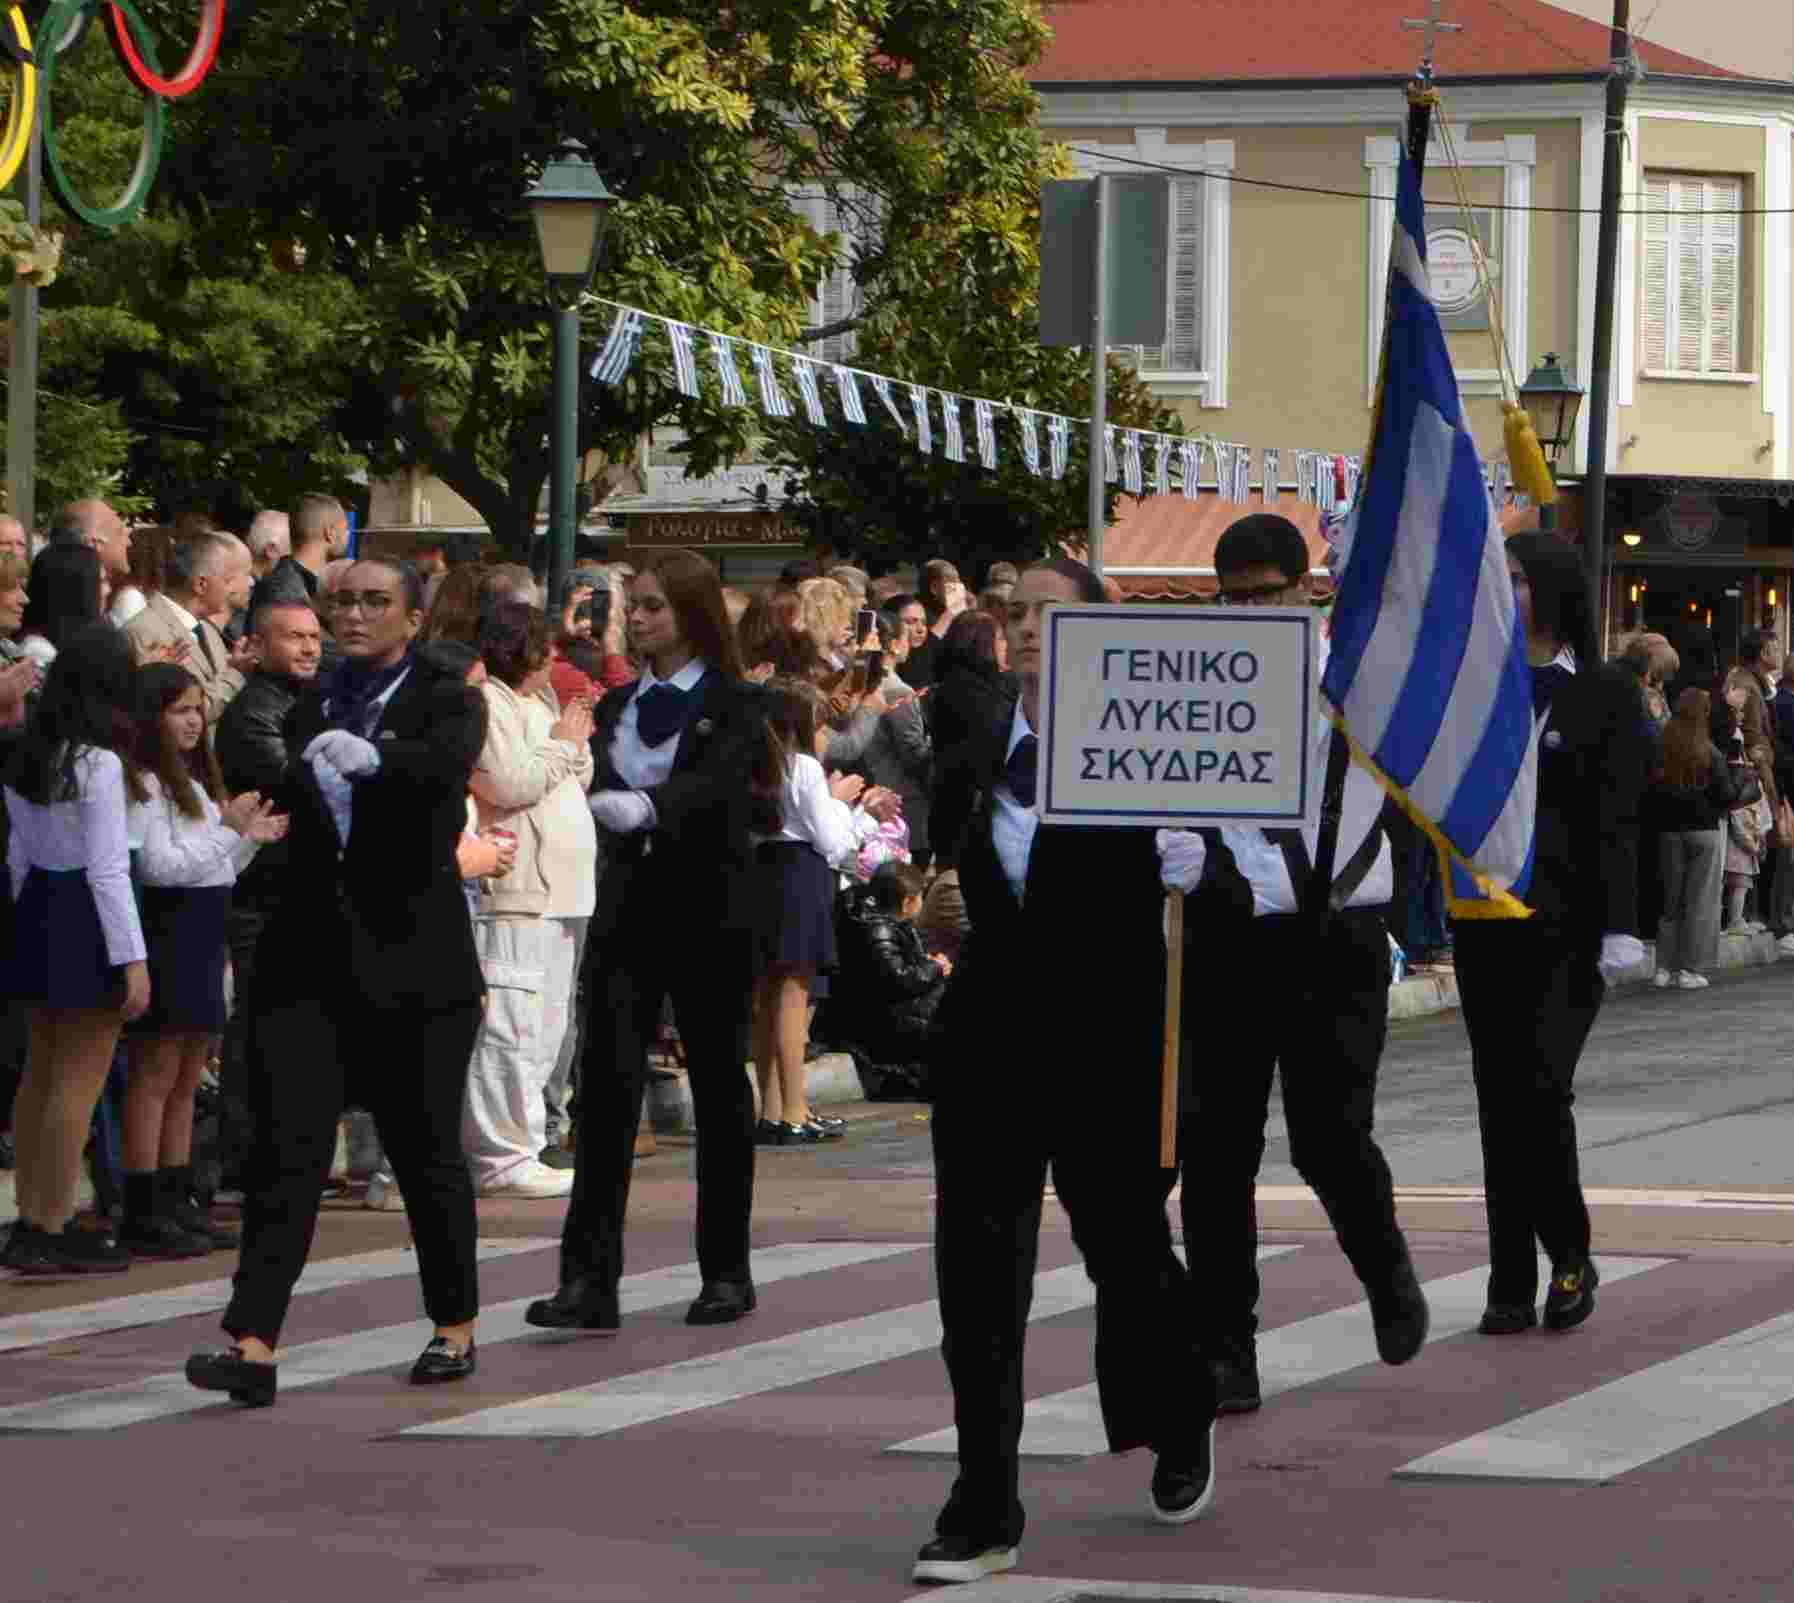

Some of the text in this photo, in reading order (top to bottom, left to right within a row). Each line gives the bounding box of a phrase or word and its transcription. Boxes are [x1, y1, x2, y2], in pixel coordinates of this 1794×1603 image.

[1102, 648, 1259, 684] ΓΕΝΙΚΟ
[1099, 698, 1257, 733] ΛΥΚΕΙΟ
[1079, 747, 1273, 784] ΣΚΥΔΡΑΣ
